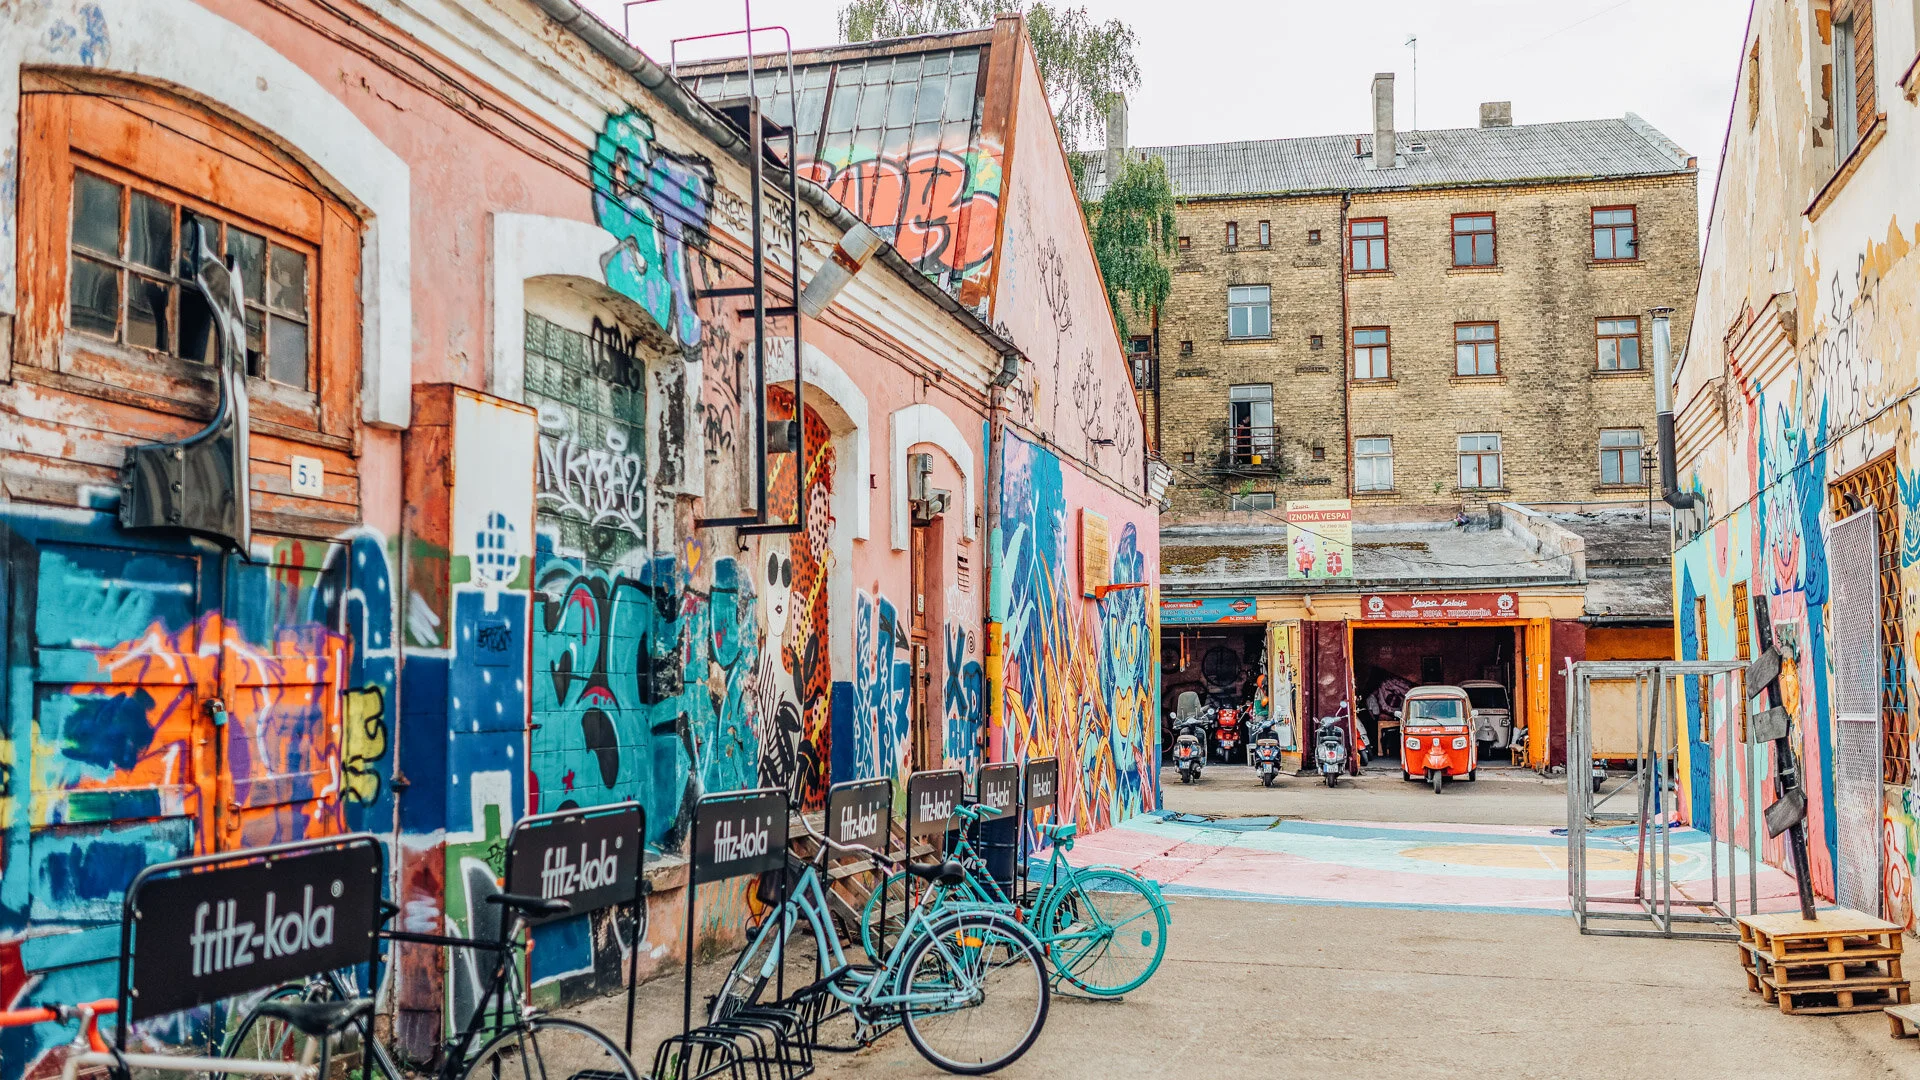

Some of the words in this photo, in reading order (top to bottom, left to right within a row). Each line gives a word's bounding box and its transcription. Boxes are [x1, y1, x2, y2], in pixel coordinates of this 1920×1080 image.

[298, 464, 307, 485] 5
[1289, 512, 1320, 521] IZNOMĀ
[1321, 512, 1349, 520] VESPA!
[1411, 596, 1440, 608] Vespa
